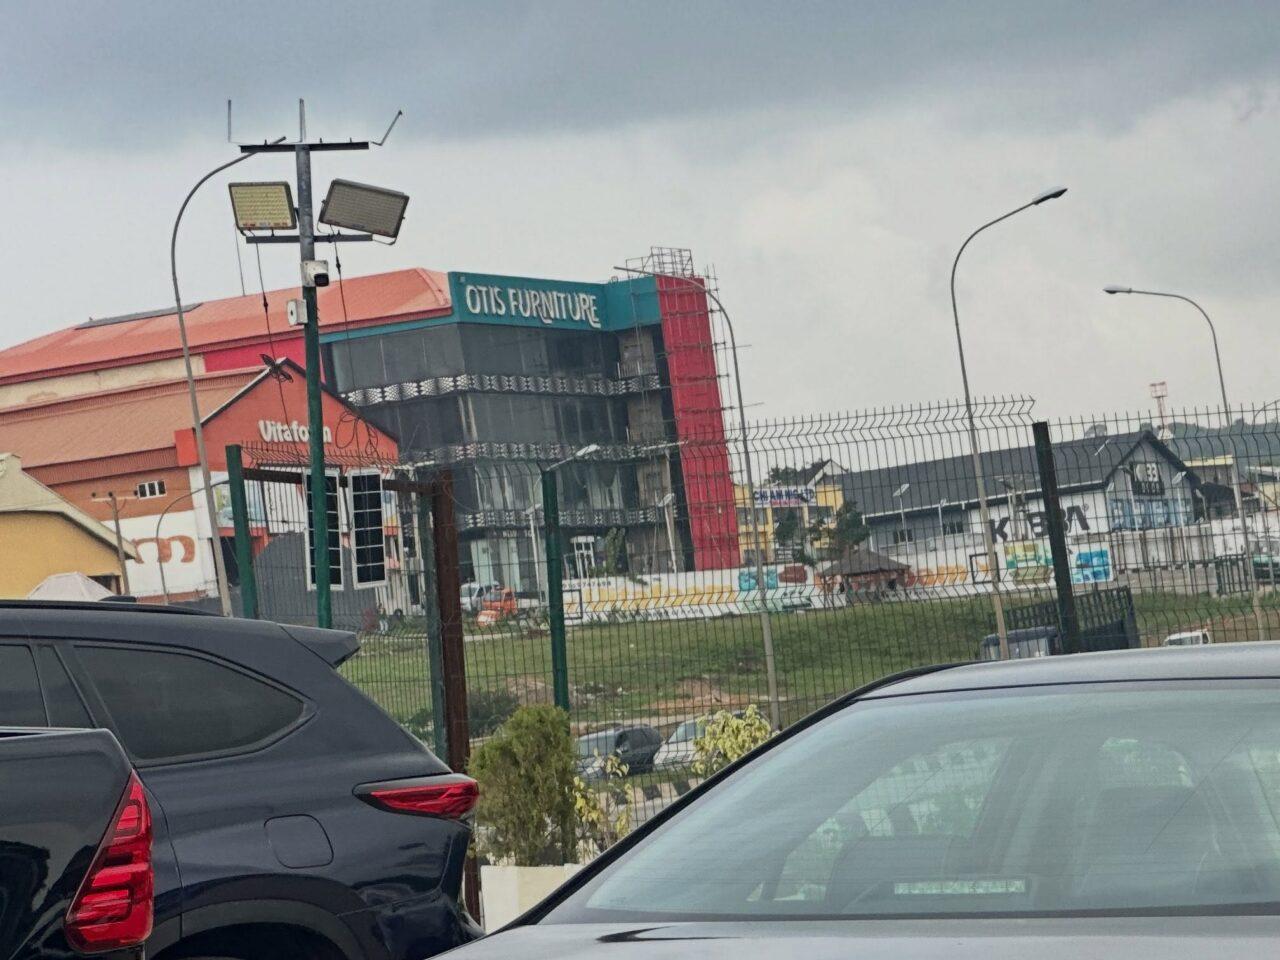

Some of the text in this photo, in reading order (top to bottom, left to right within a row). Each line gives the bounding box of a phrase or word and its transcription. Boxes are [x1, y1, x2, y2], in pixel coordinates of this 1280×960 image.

[465, 285, 601, 328] OTIS FURNITURE
[258, 420, 332, 443] Vitafom
